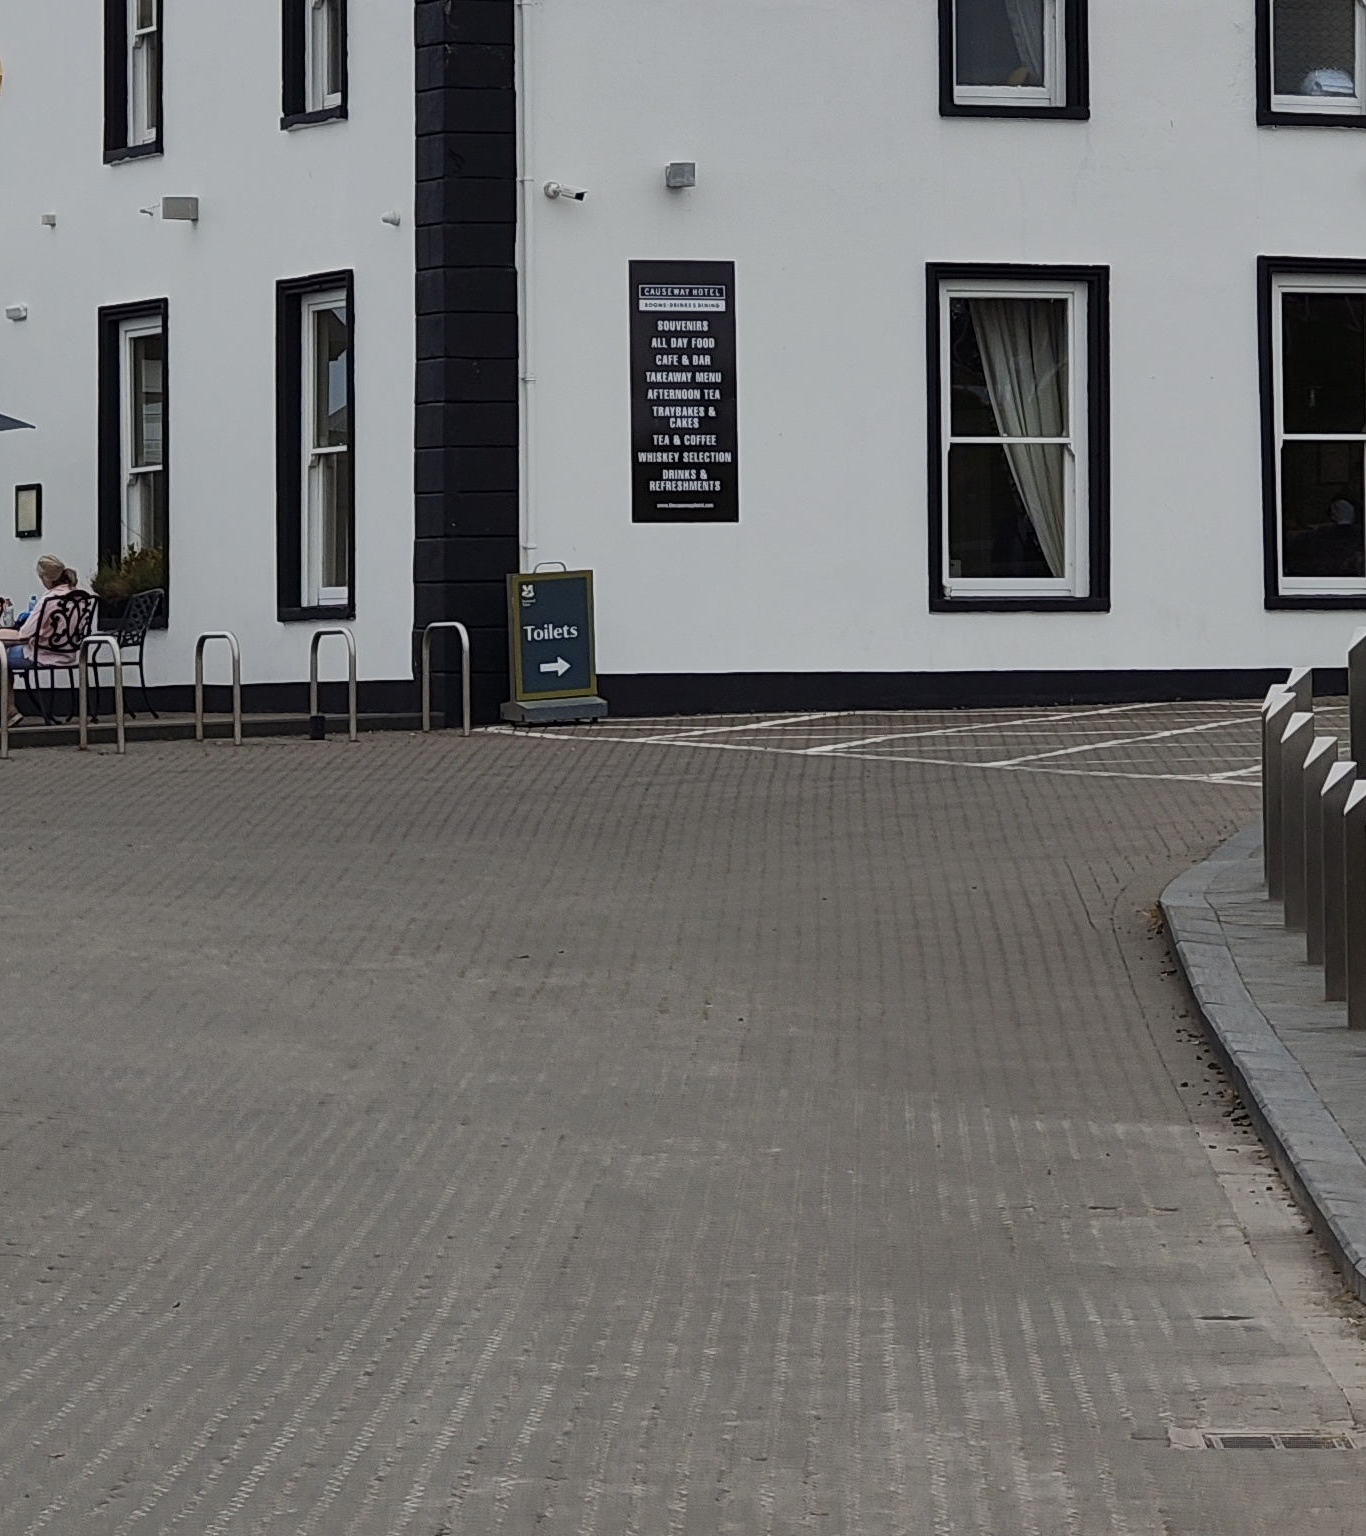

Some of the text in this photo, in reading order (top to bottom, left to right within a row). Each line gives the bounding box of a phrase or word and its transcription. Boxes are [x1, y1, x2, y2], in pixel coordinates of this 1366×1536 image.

[657, 320, 708, 331] SOUVENIRS
[651, 338, 715, 348] ALL DAY FOOD
[656, 355, 678, 365] CAFE
[682, 355, 689, 365] &
[646, 372, 722, 382] TAKEAWAY MENU
[647, 389, 720, 399] AFTERNOON TEA
[652, 406, 716, 417] TRAYBAKES &
[670, 418, 699, 428] CAKES
[653, 435, 716, 445] TEA & COFFEE
[638, 452, 731, 462] WHISKEY SELECTION
[662, 469, 707, 479] DRINKS &
[650, 481, 720, 491] REFRESHMENTS
[523, 623, 578, 641] Toilets
